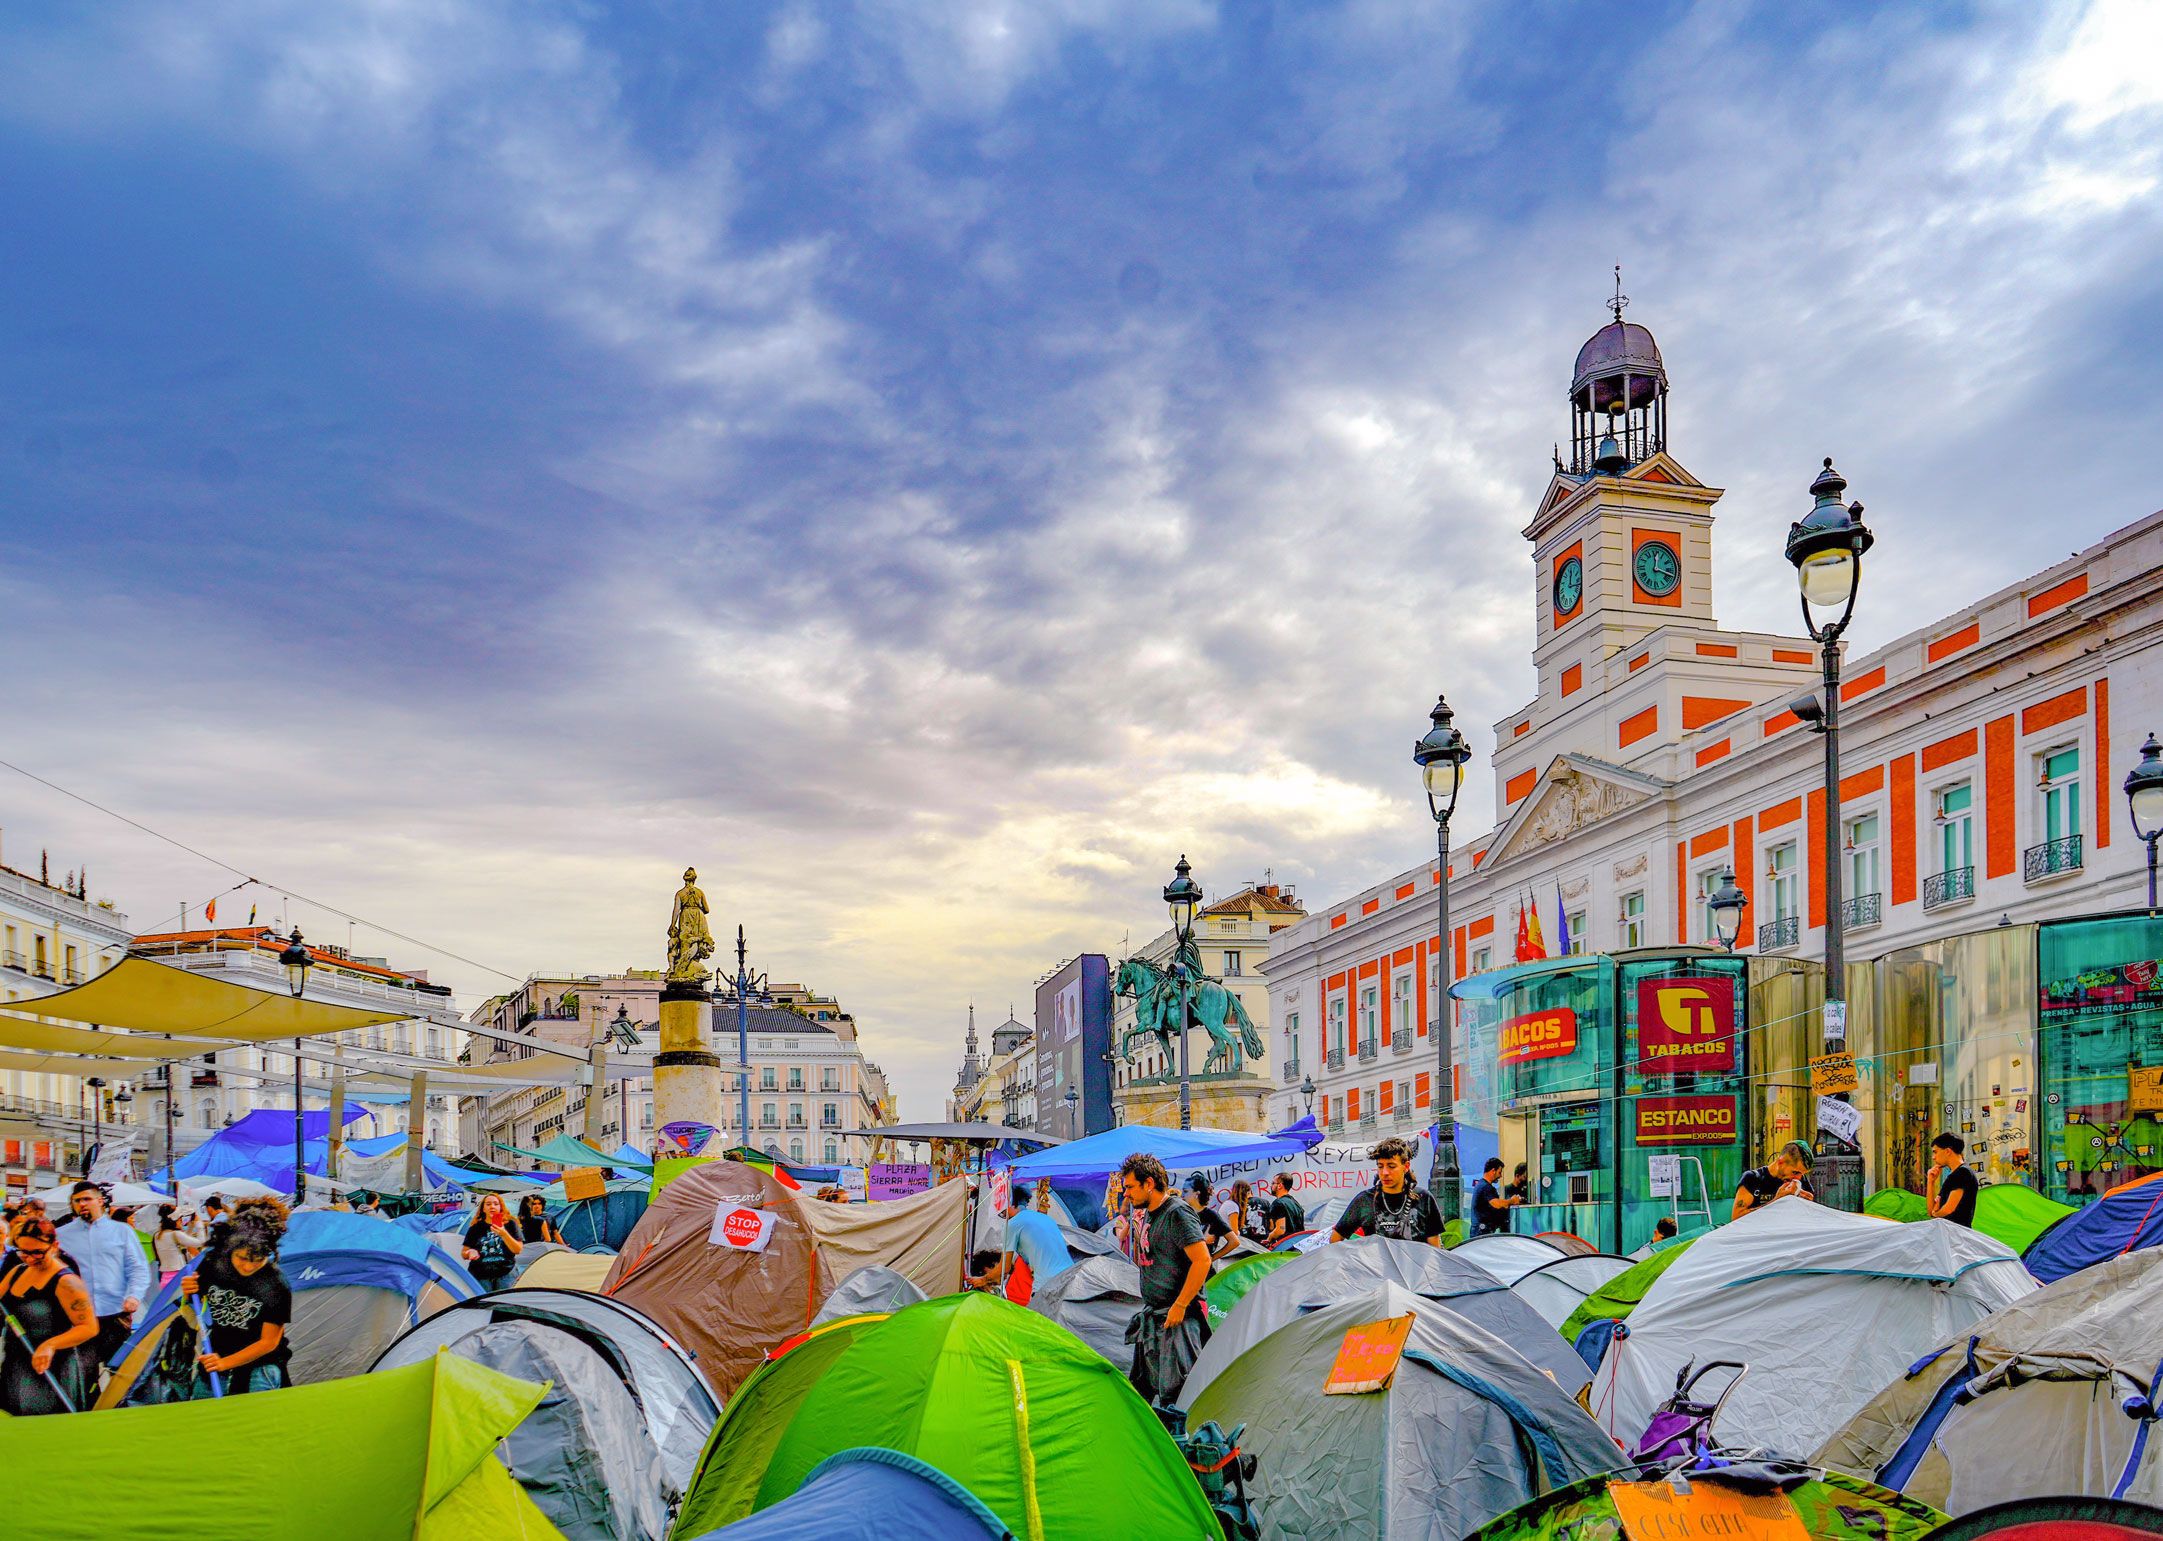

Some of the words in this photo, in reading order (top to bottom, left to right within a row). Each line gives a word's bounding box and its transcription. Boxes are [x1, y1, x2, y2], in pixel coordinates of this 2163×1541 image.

[2041, 1008, 2075, 1018] PRENSA
[2080, 1003, 2125, 1015] REVISTAS
[2131, 1000, 2156, 1012] AGUA
[1499, 1018, 1561, 1051] BACOS
[1647, 1042, 1726, 1057] TABACOS
[1641, 1108, 1732, 1128] ESTANCO
[886, 1164, 917, 1175] PLAZA
[908, 1176, 929, 1188] NORTE
[728, 1215, 760, 1229] STOP
[724, 1226, 759, 1240] DESAHUCIOS
